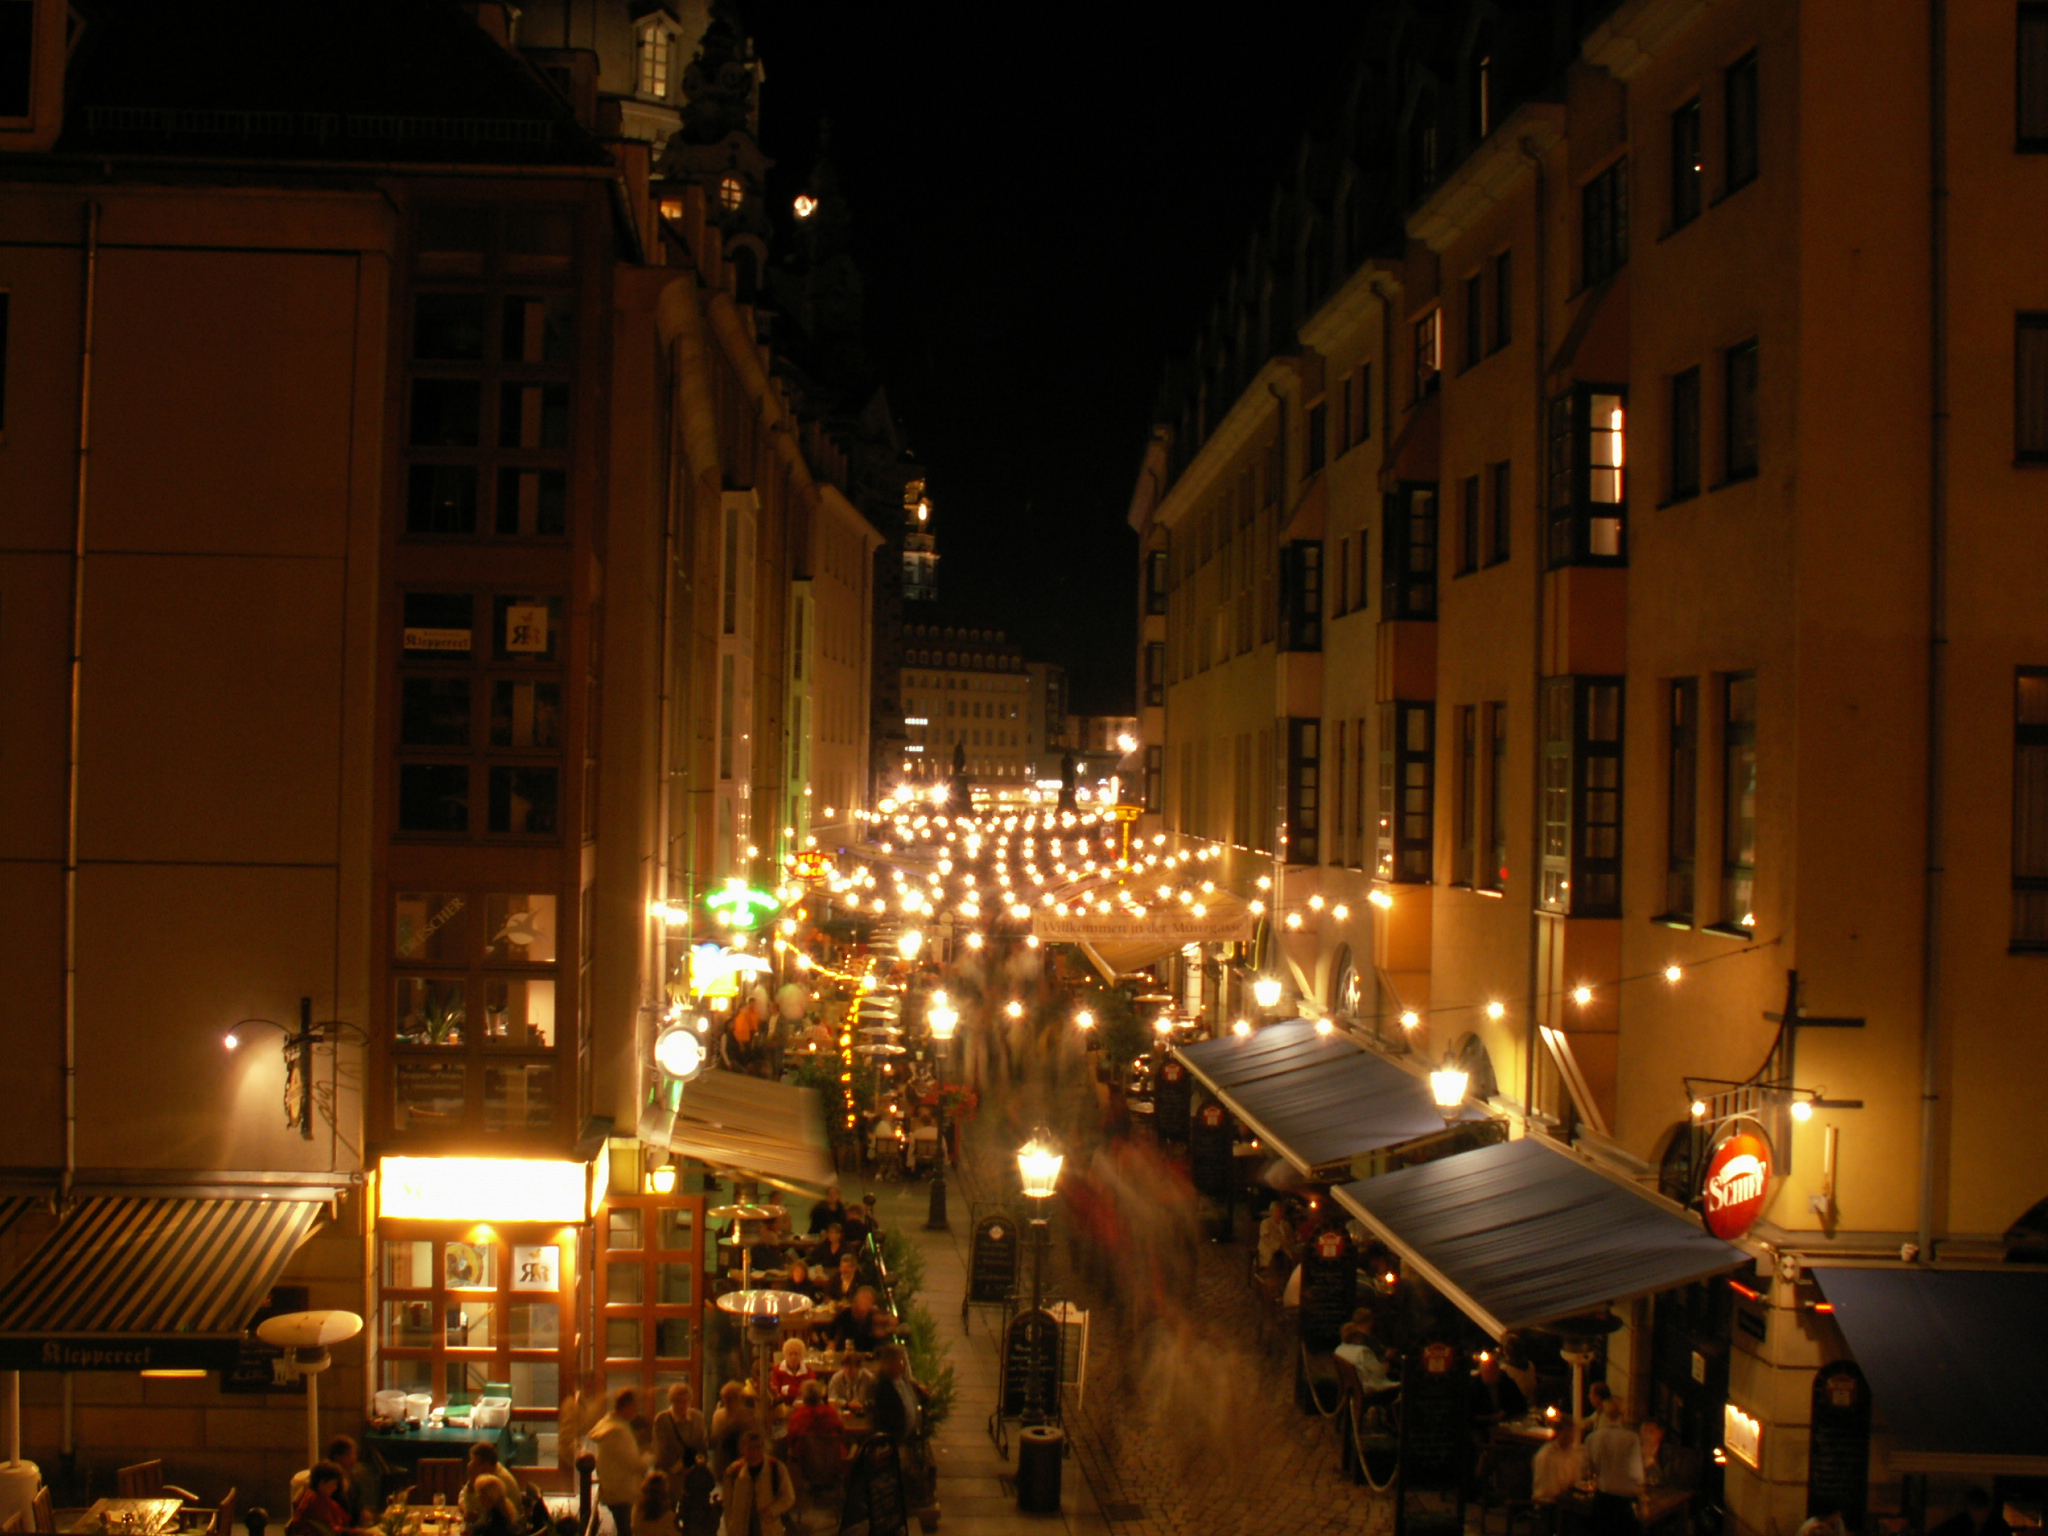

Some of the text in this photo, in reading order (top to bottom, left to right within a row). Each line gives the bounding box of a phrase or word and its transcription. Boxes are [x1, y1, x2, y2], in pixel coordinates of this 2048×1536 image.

[1042, 919, 1127, 934] Willkommen
[1131, 919, 1144, 934] in
[1148, 918, 1166, 934] der
